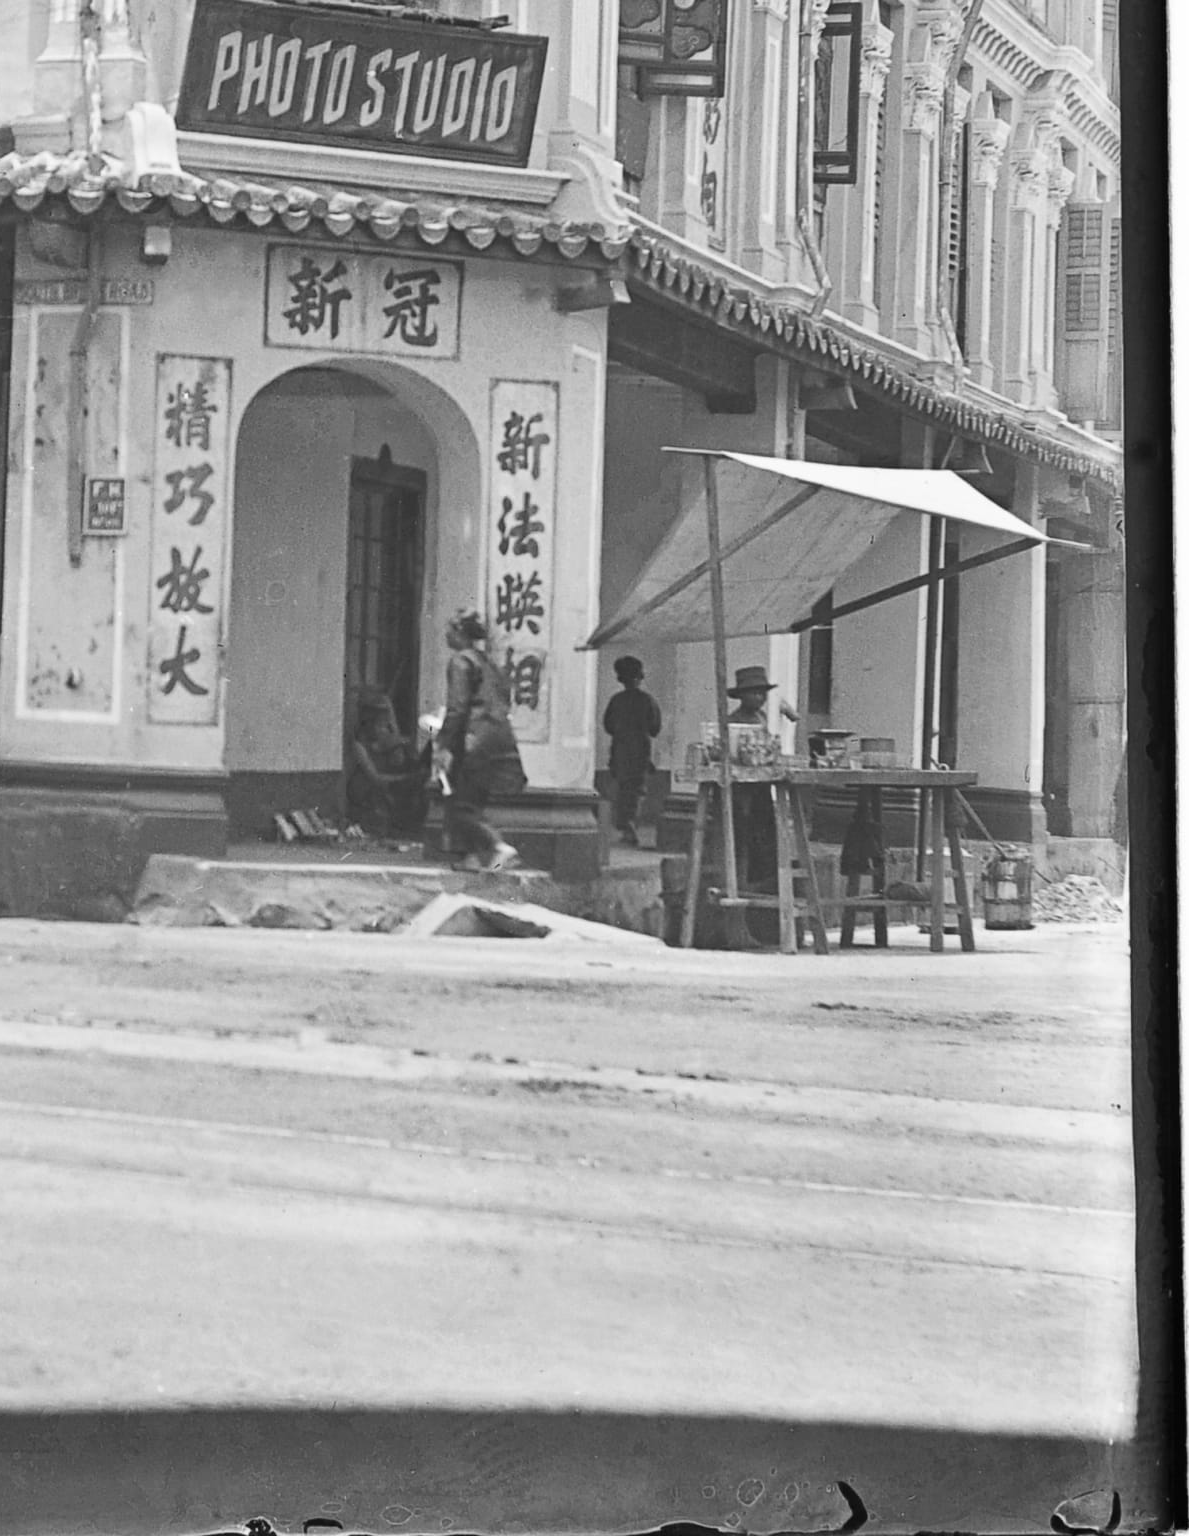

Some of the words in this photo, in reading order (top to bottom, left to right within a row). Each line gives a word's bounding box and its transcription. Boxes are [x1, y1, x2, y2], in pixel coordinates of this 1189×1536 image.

[207, 30, 357, 125] PHOTO
[360, 47, 518, 142] STUDIO
[156, 381, 218, 696] 精巧放大
